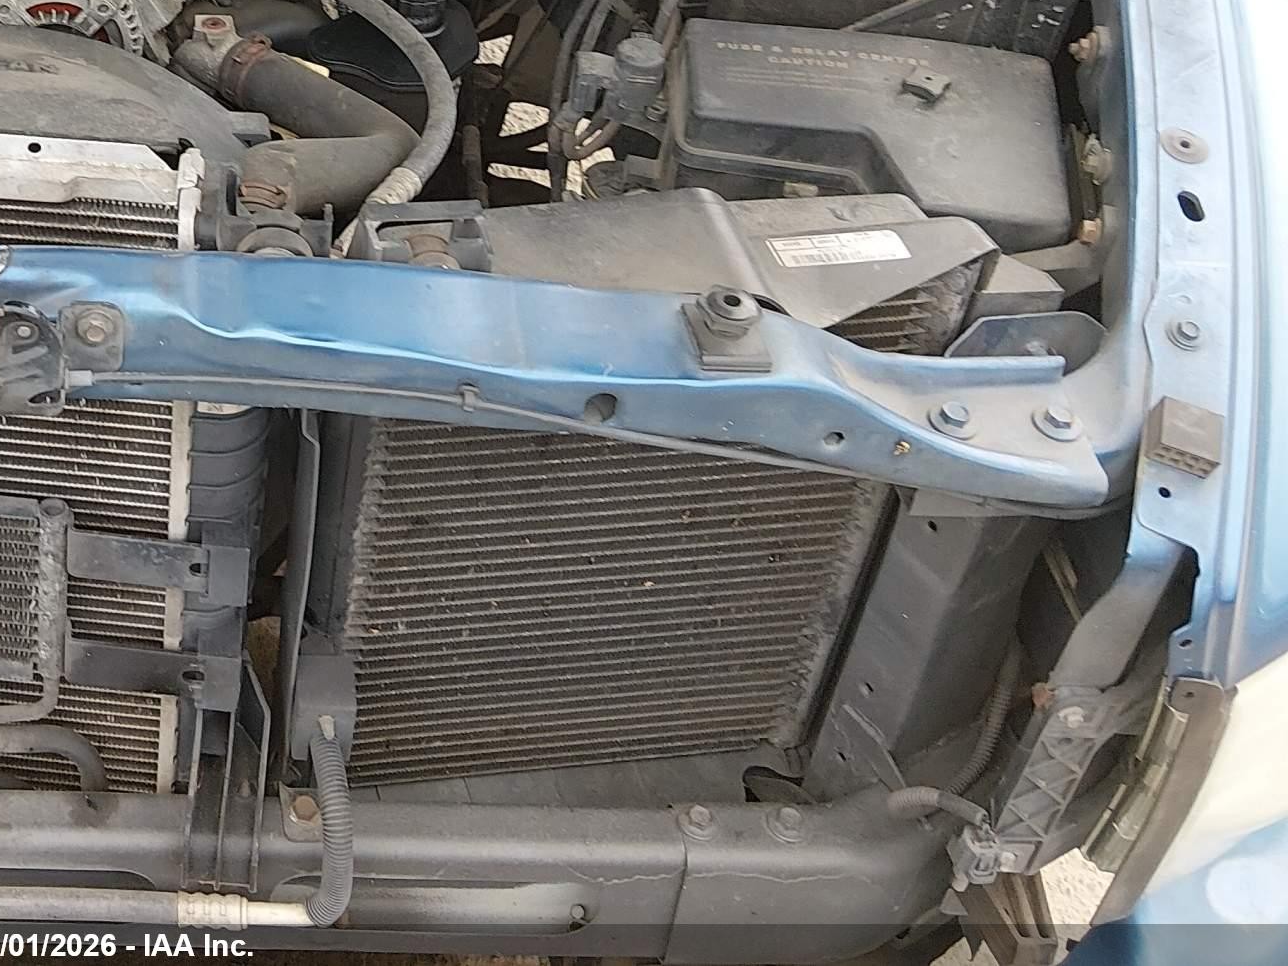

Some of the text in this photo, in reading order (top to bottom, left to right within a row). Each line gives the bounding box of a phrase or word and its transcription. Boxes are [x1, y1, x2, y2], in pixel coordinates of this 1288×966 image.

[716, 41, 762, 52] FUSE
[791, 46, 851, 58] RELAY
[767, 56, 849, 69] CAUTION
